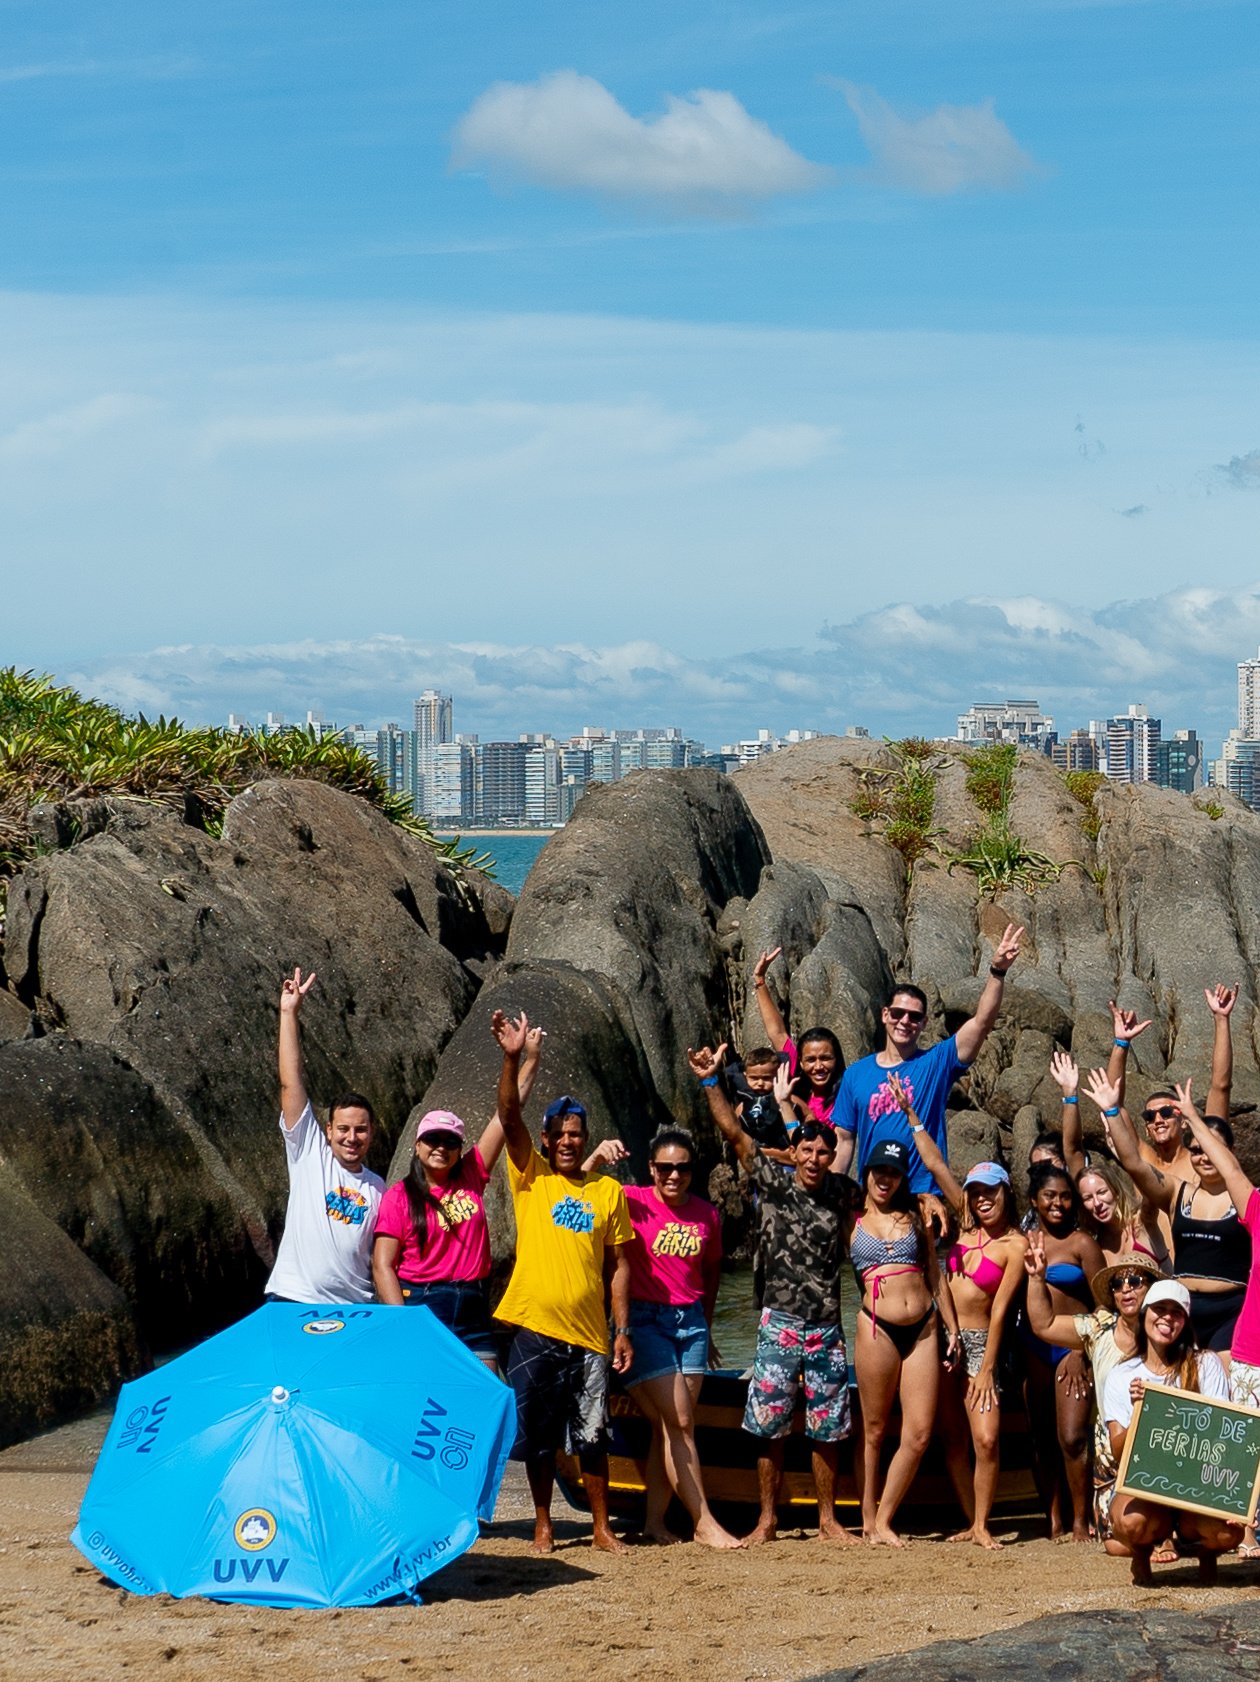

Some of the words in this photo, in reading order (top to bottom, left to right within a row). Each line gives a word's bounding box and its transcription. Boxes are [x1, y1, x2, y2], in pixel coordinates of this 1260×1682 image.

[298, 1309, 373, 1318] UVV
[136, 1395, 172, 1453] UVV
[411, 1397, 448, 1461] UVV
[1176, 1406, 1213, 1431] TÔ
[1220, 1415, 1247, 1443] DE
[1149, 1424, 1226, 1465] FÉRIAS
[1201, 1463, 1240, 1490] UVV
[213, 1558, 290, 1583] UVV
